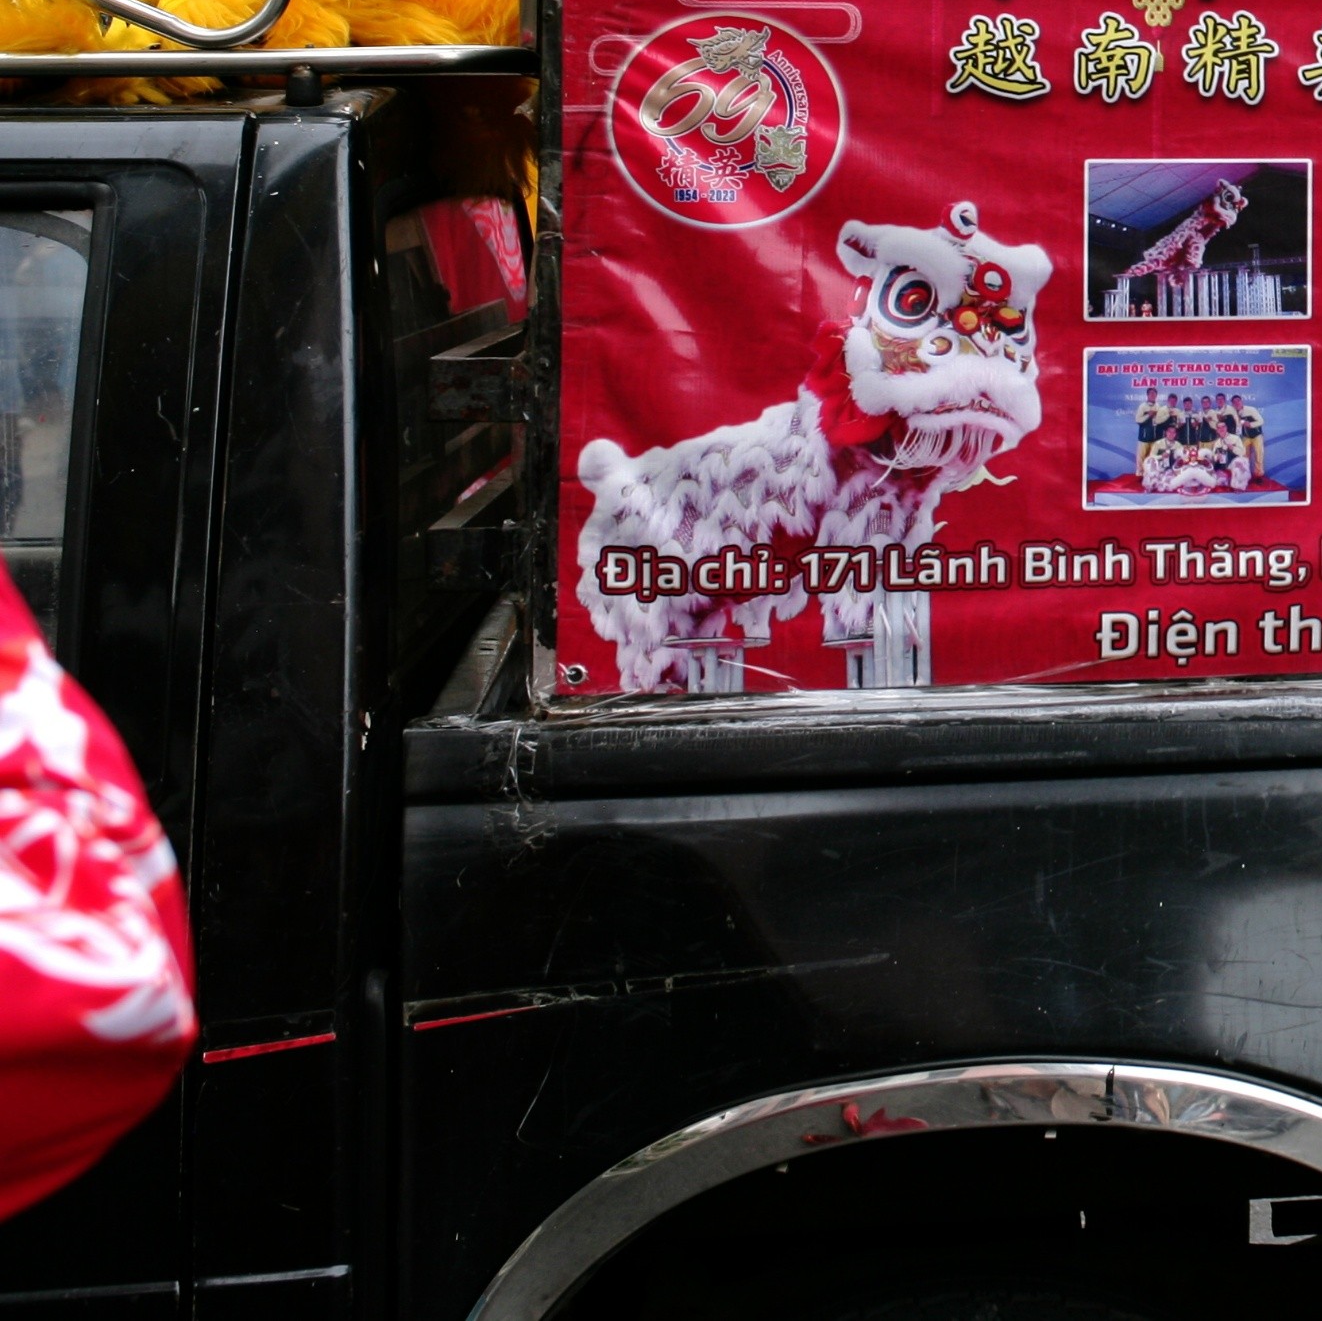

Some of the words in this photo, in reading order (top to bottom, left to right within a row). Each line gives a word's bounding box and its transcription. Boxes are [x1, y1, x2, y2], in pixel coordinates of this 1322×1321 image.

[639, 56, 777, 145] 69
[767, 49, 809, 124] Anniversary
[656, 147, 749, 190] 精英
[674, 190, 699, 202] 1954
[1178, 363, 1211, 374] THAO
[1216, 377, 1249, 387] 2022
[602, 551, 682, 599] Địa
[697, 550, 786, 589] chỉ:
[801, 551, 875, 588] 171
[890, 545, 1005, 586] Lãnh
[1025, 541, 1131, 583] Bình
[1145, 541, 1308, 587] Thăng,
[1096, 609, 1238, 666] Điện
